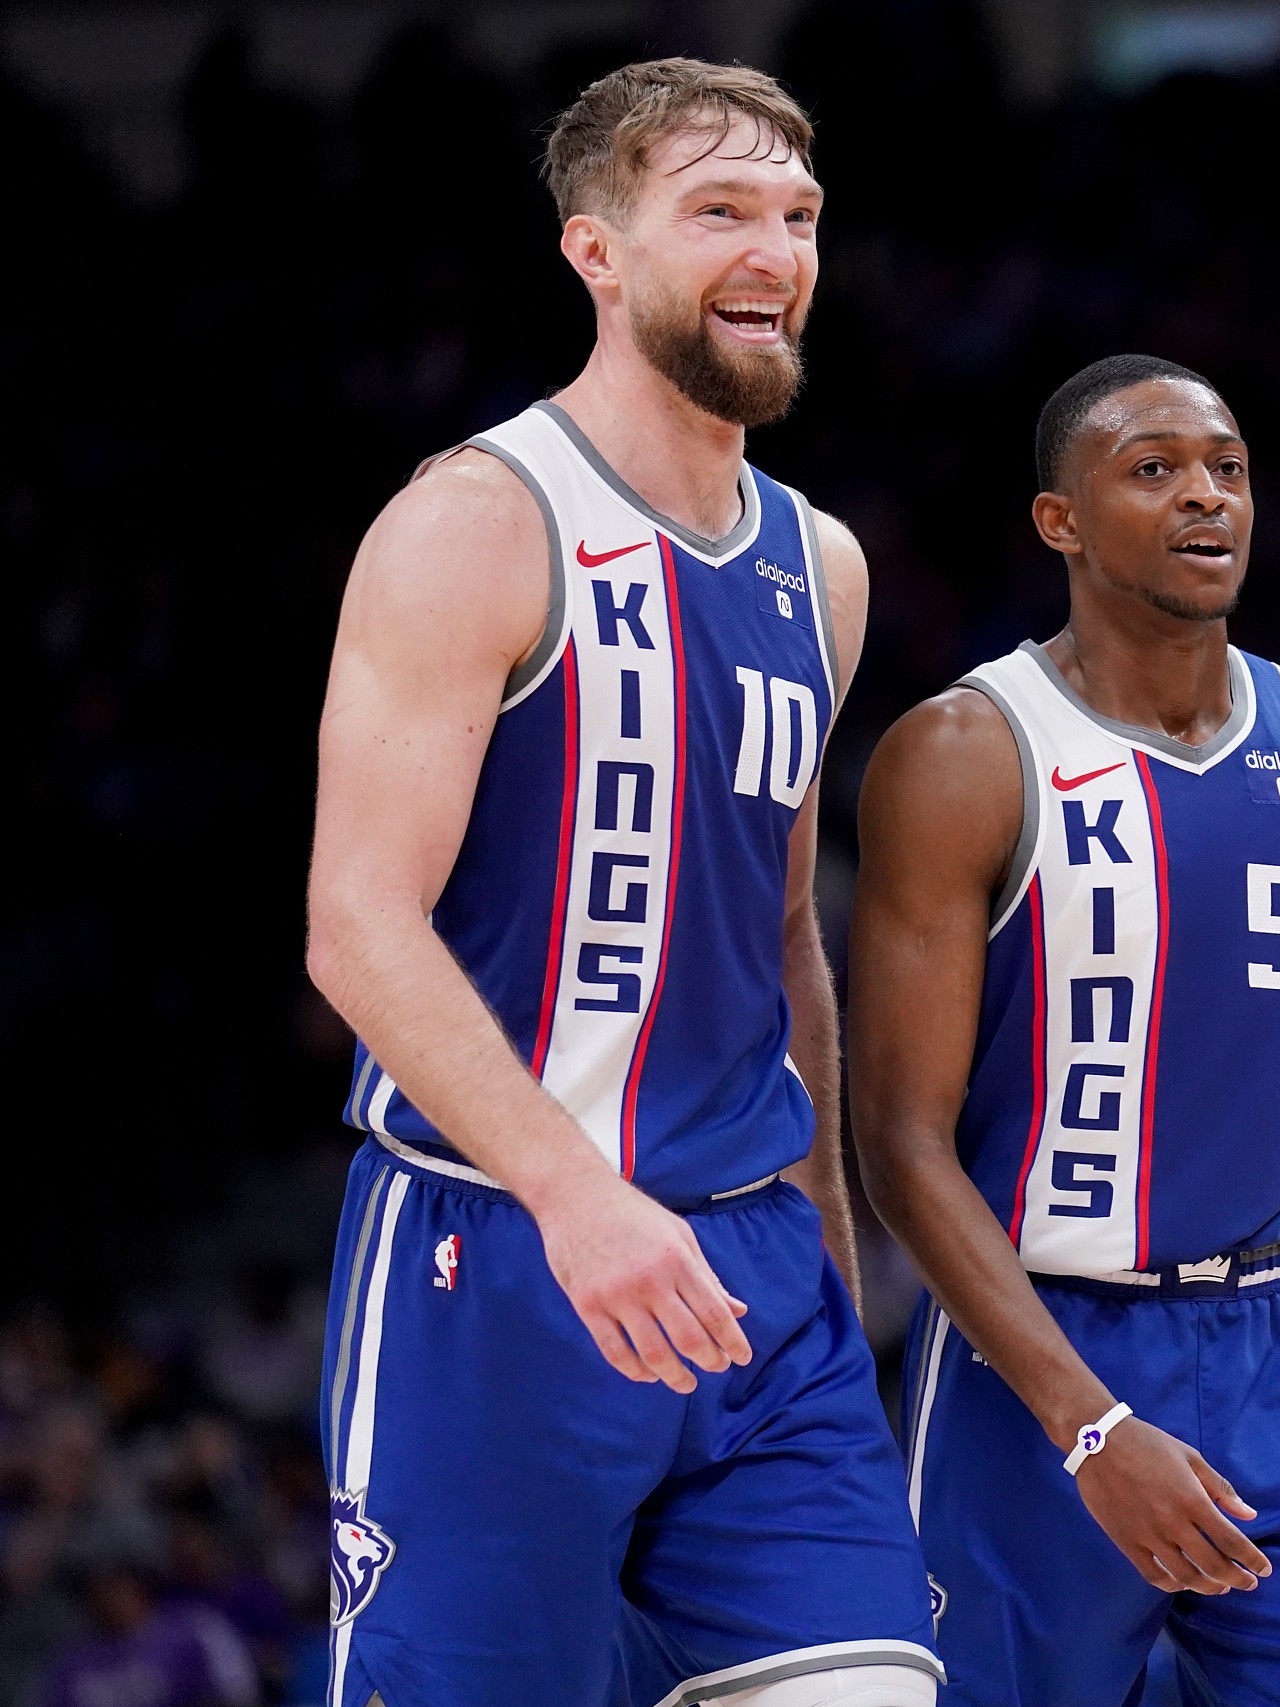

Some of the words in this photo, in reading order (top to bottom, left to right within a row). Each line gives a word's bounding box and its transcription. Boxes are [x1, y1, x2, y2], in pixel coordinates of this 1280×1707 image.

[755, 557, 806, 593] dialpad
[733, 665, 818, 810] 10
[433, 1276, 447, 1288] NBA
